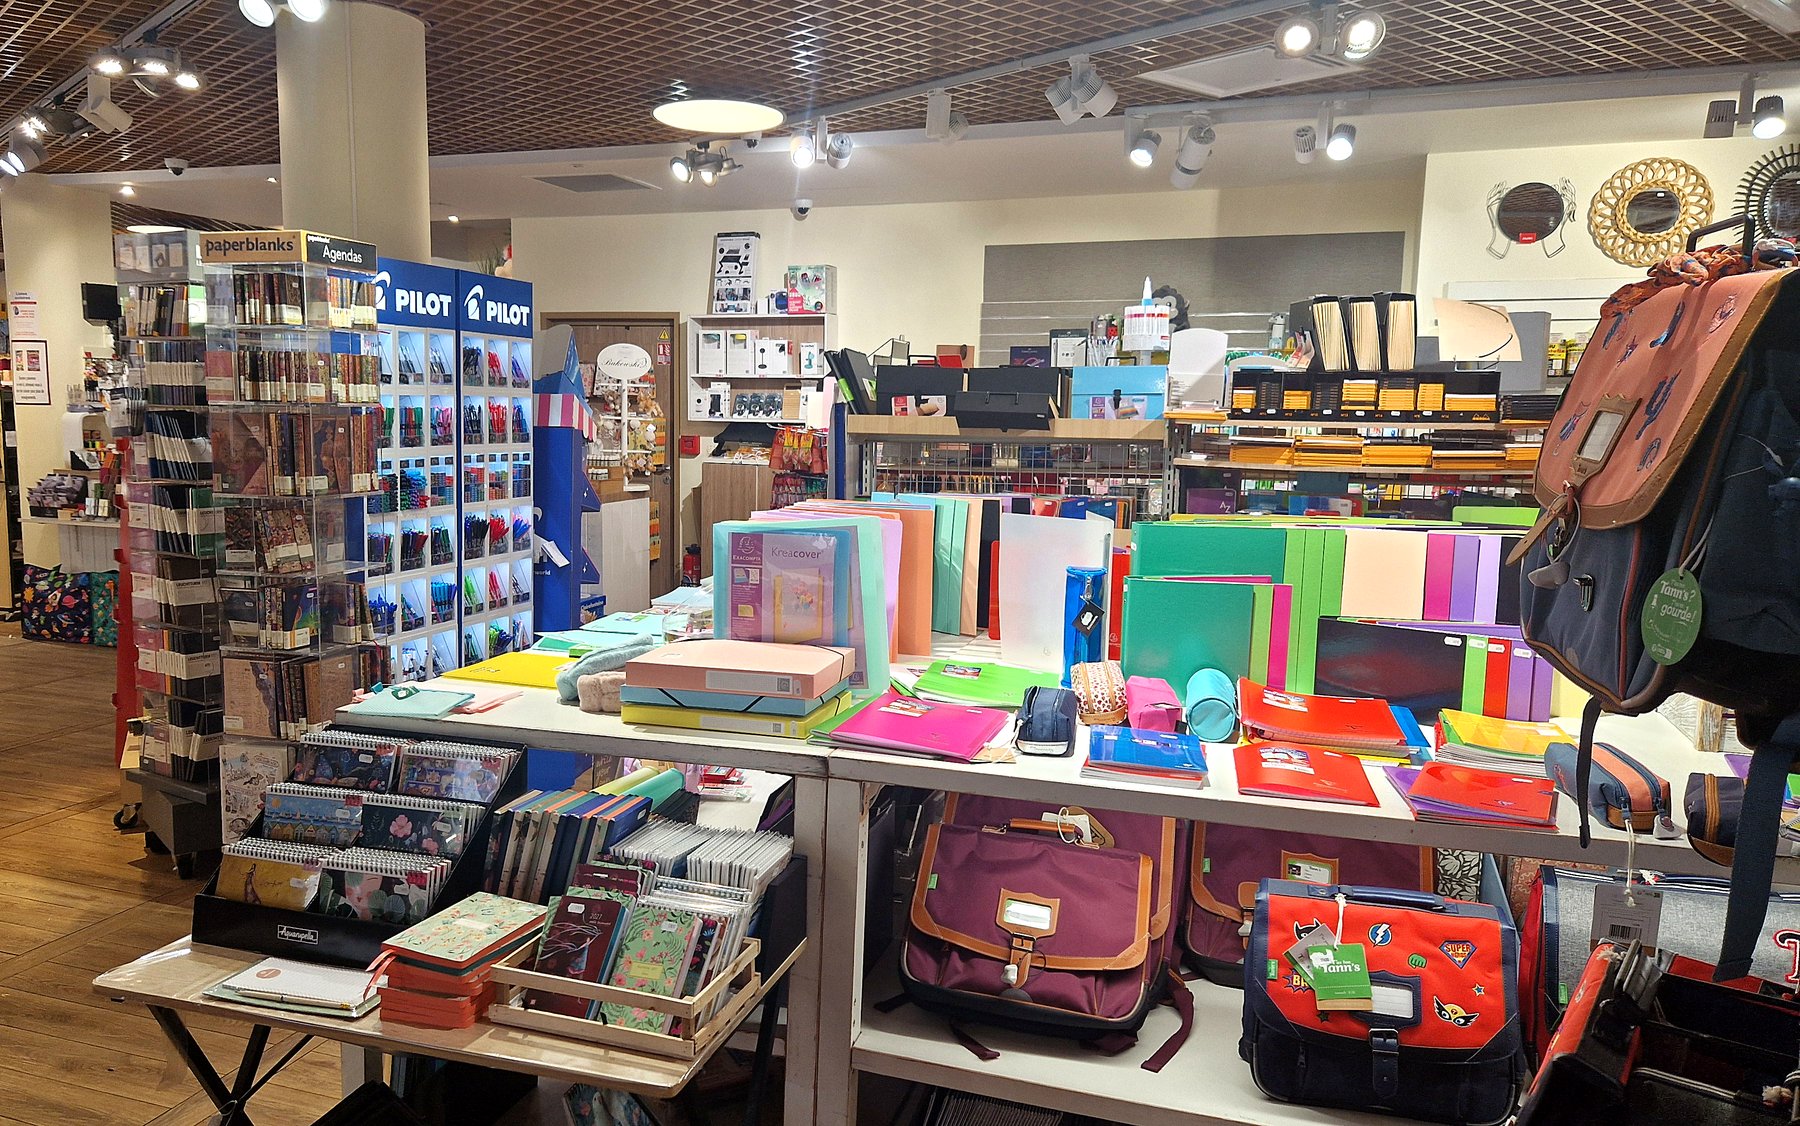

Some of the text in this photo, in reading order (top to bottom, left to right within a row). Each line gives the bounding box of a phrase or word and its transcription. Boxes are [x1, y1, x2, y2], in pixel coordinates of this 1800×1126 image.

[205, 237, 294, 256] paperblanks
[322, 245, 363, 264] Agendas
[395, 288, 452, 317] PILOT
[486, 300, 530, 326] PILOT
[732, 554, 761, 562] EXACOMPTA
[771, 546, 821, 559] Kreacover
[1660, 580, 1697, 602] Tann's?
[1660, 603, 1697, 623] gourde!
[1445, 943, 1472, 953] SUPER
[1322, 963, 1361, 974] Tann's
